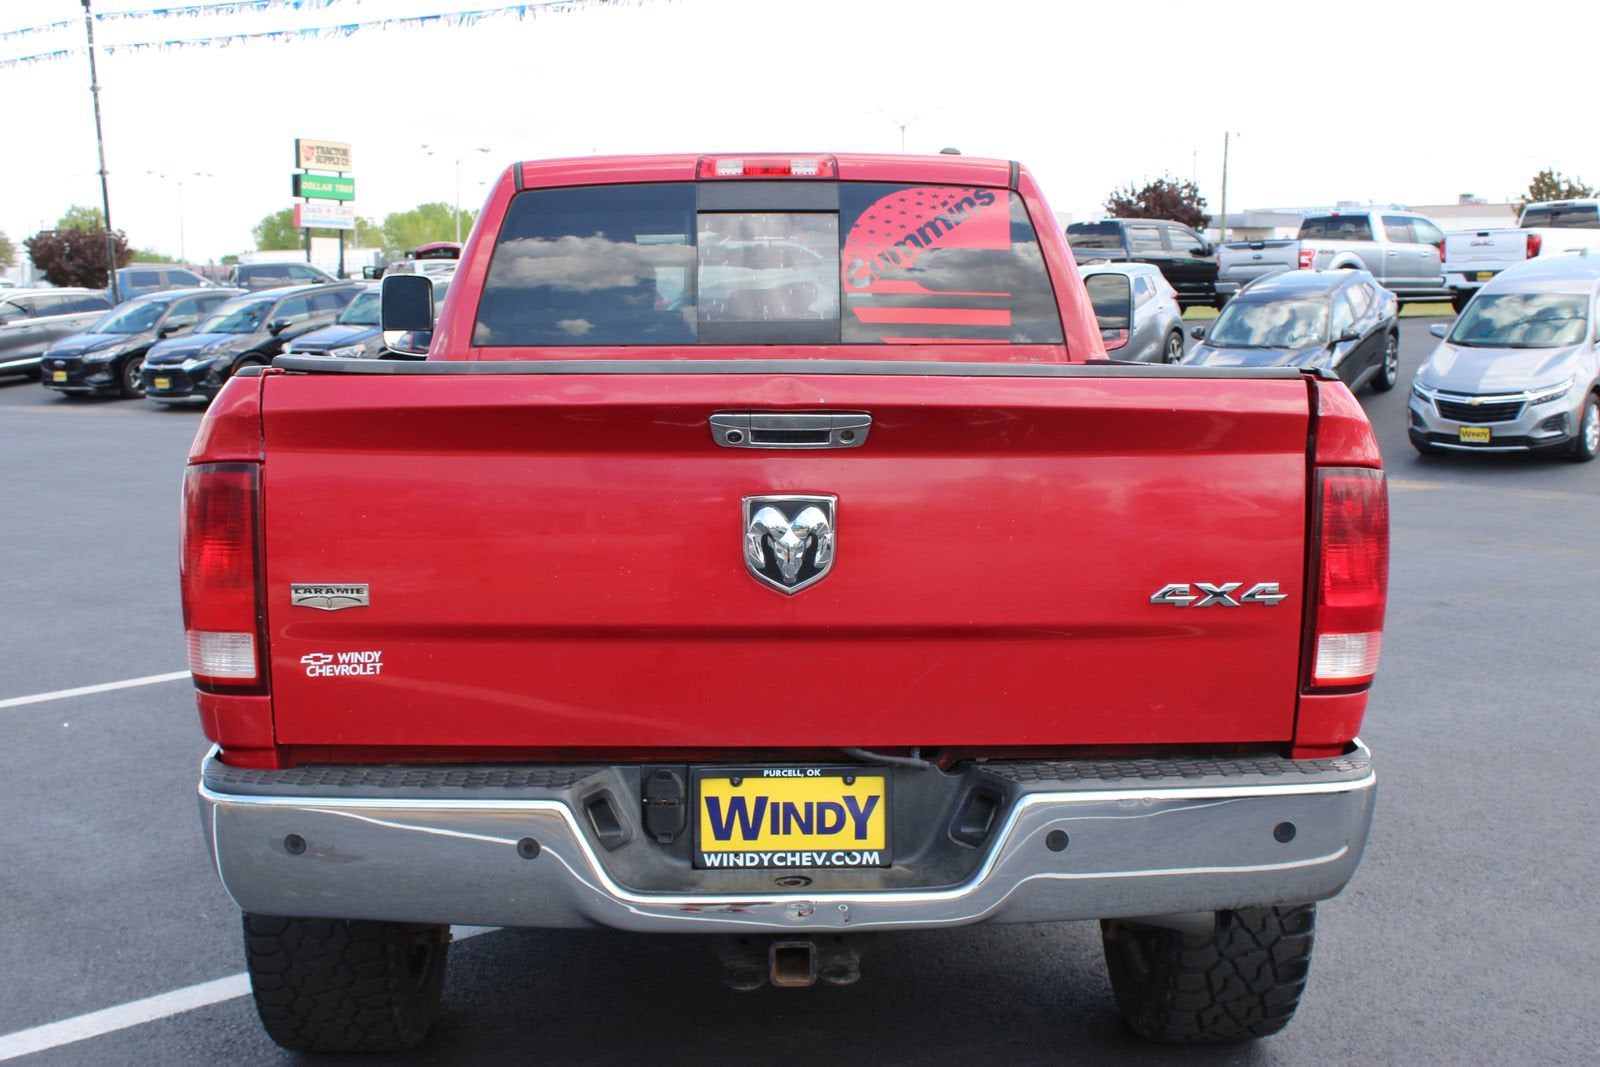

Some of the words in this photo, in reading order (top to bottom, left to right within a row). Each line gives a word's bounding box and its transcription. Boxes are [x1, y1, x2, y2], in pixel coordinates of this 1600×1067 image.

[315, 145, 349, 157] TRACTOR
[846, 187, 996, 289] Cummins
[293, 587, 365, 595] LARAMIE
[337, 651, 382, 664] WINDY
[306, 663, 383, 677] CHEVROLET
[763, 769, 805, 778] PURCELL,
[806, 769, 821, 777] OK
[704, 795, 881, 841] WINDY
[703, 851, 880, 867] WINDYCHEV.COM
